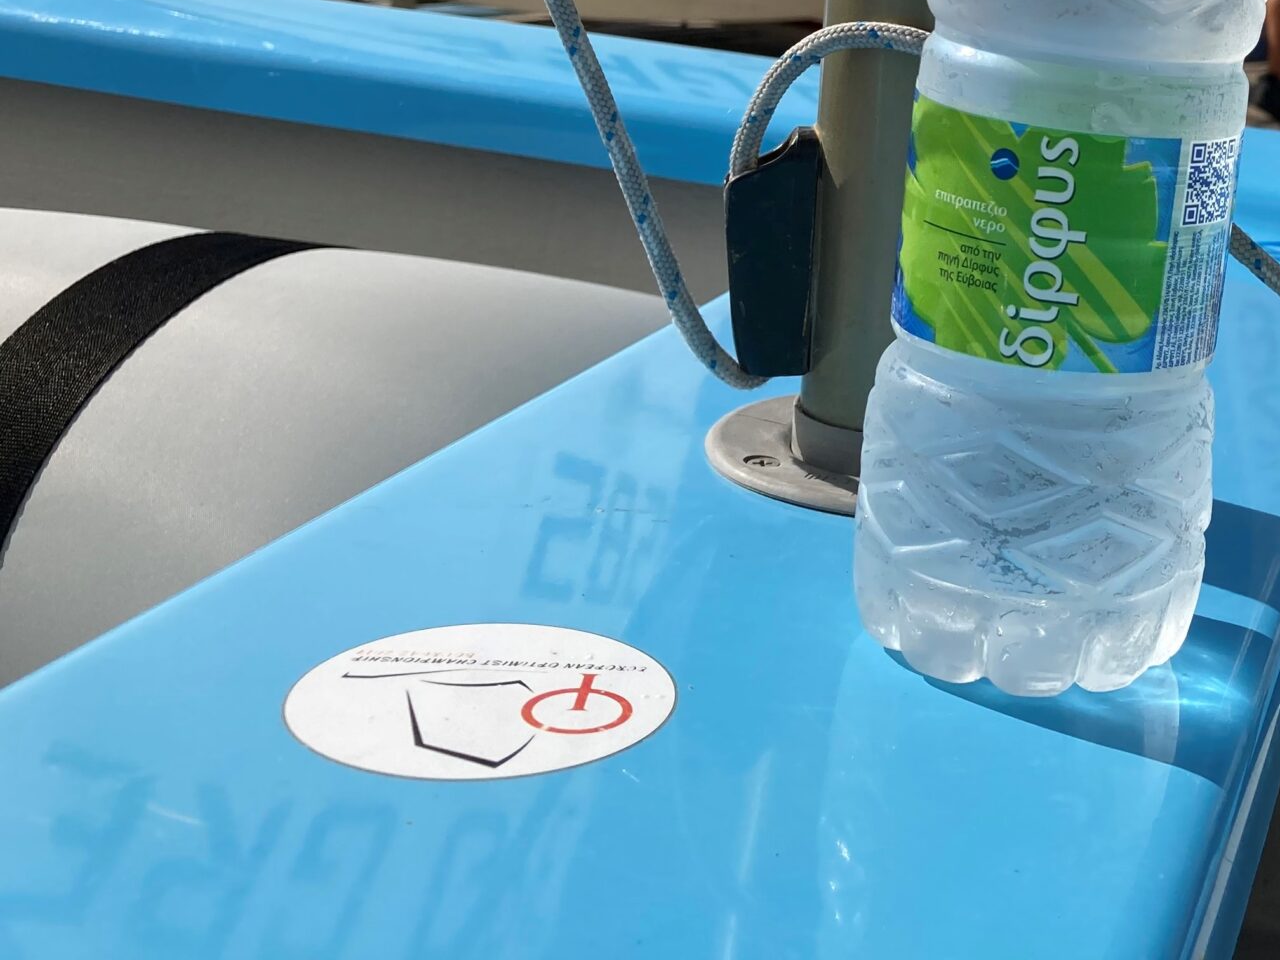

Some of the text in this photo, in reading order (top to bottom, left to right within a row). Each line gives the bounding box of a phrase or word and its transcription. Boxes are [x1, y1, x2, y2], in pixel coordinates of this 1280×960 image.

[972, 217, 1005, 234] νερο
[937, 251, 959, 268] πηγή
[960, 244, 1002, 263] από την
[939, 268, 998, 293] της Εύβοιας
[351, 655, 478, 666] CHAMPIONSHIP
[480, 659, 560, 669] OPTIMIST
